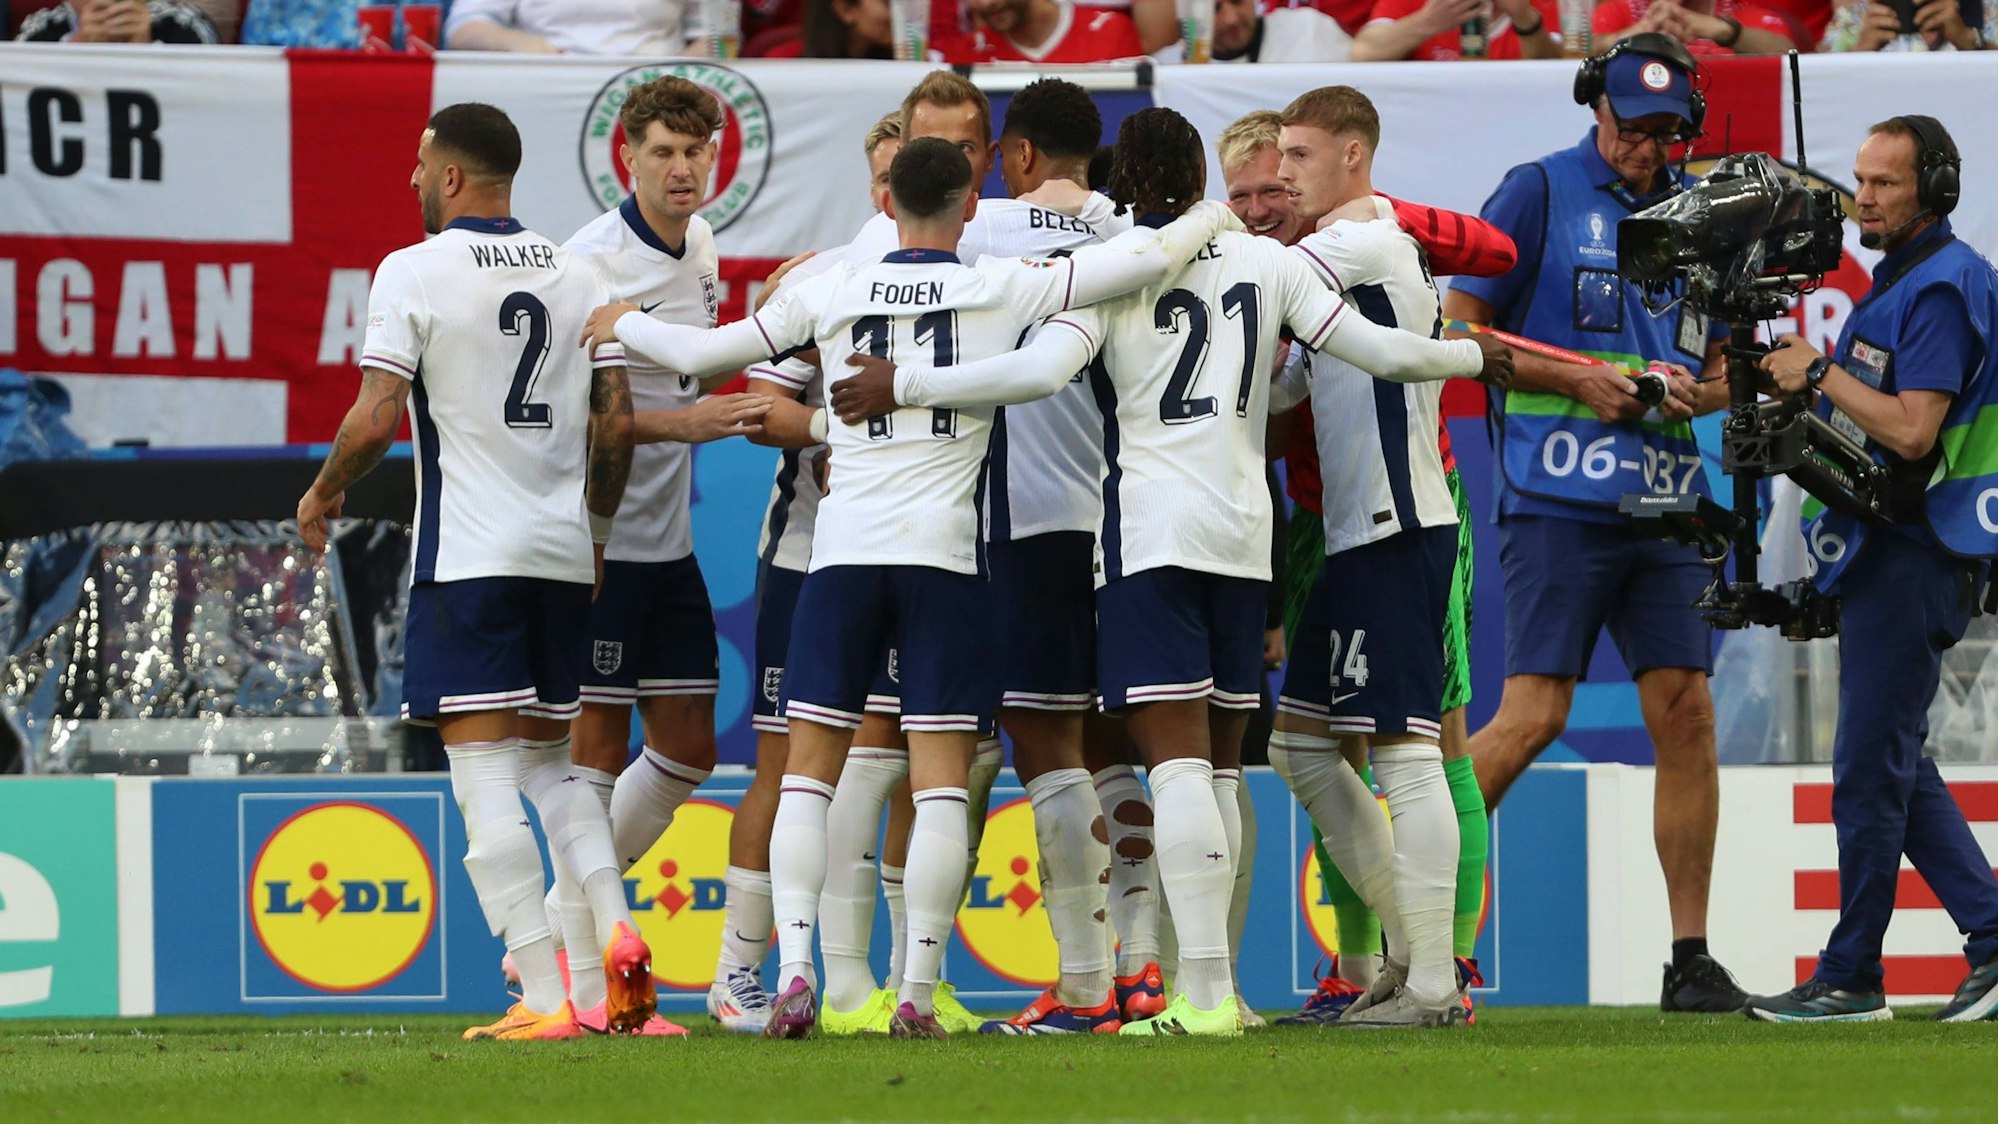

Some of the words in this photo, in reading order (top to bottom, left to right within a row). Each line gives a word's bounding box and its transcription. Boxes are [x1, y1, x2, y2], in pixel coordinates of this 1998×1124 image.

[0, 87, 163, 181] CR
[469, 244, 558, 270] WALKER
[870, 281, 943, 306] FODEN
[500, 291, 553, 428] 2
[852, 308, 960, 441] 11
[1154, 282, 1262, 426] 21
[1330, 629, 1370, 687] 24
[263, 861, 421, 922] LIDL
[622, 858, 727, 920] LID
